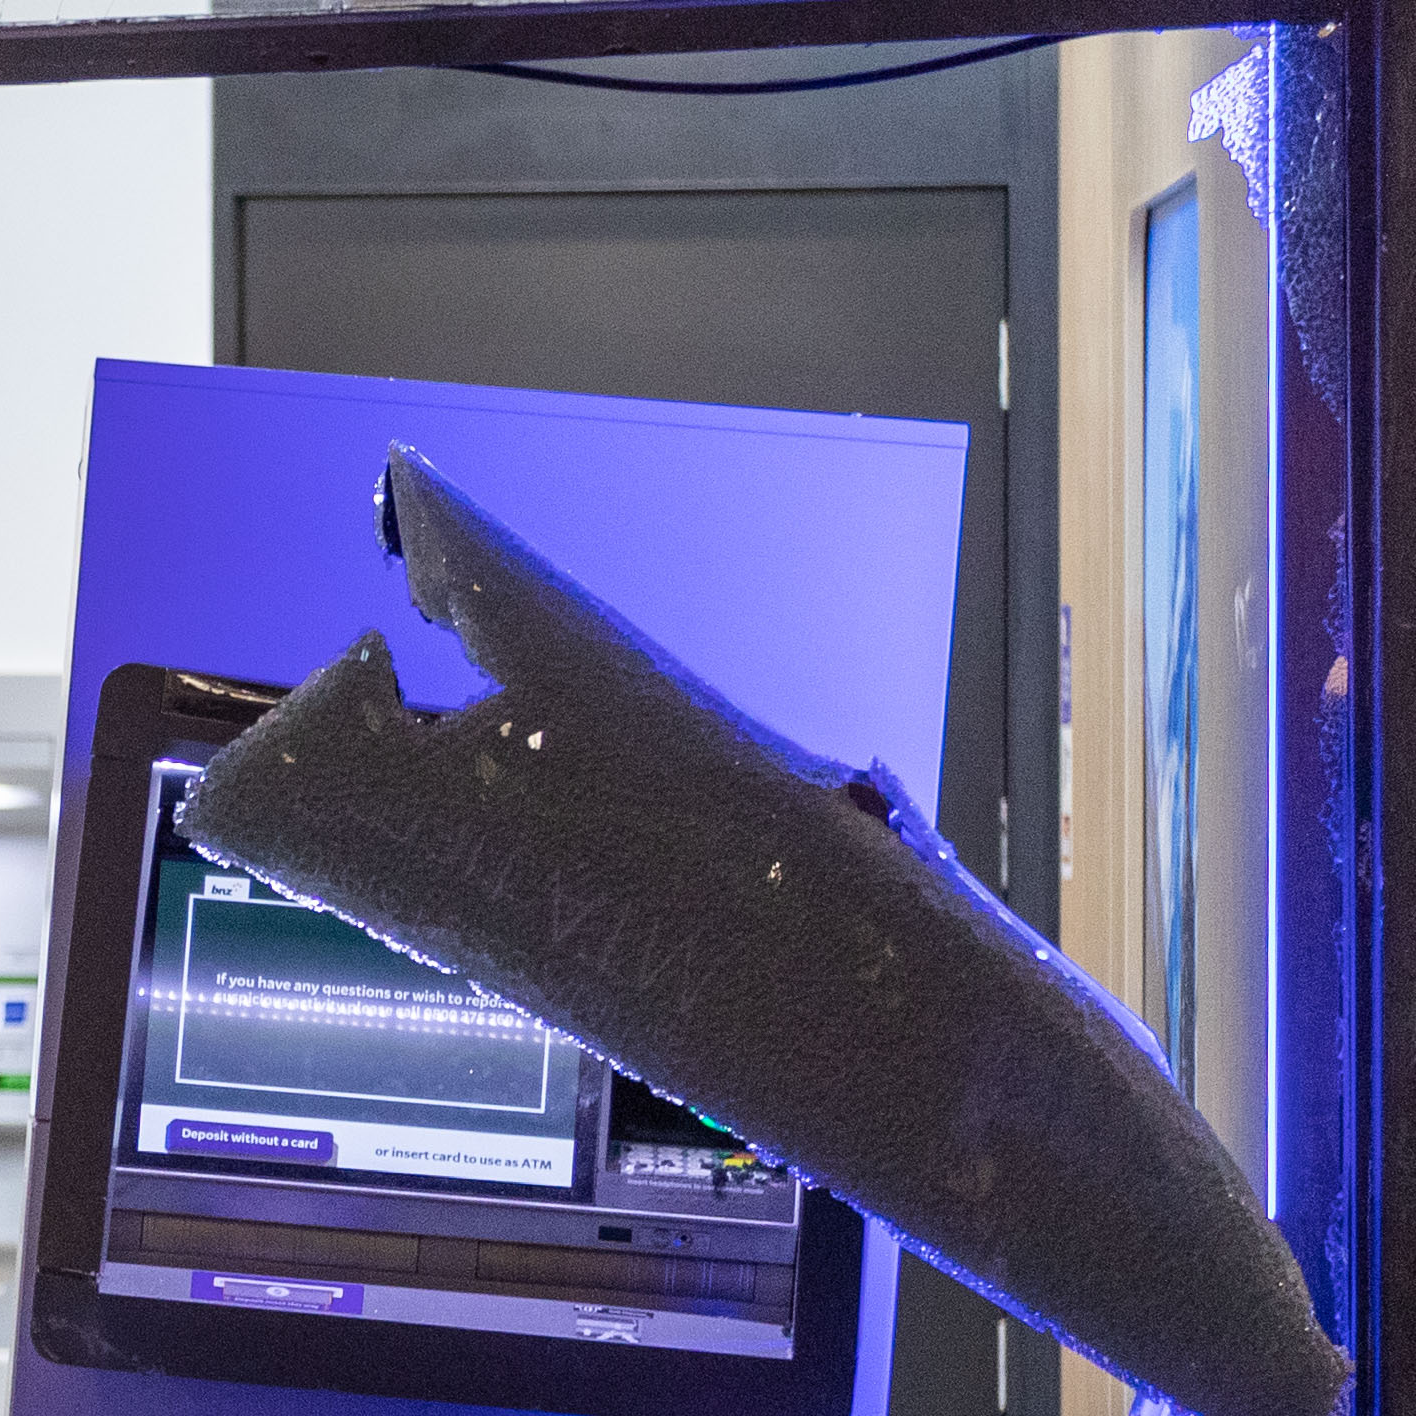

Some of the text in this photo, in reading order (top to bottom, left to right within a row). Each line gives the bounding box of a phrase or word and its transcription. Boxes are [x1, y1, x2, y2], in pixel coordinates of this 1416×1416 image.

[211, 884, 233, 896] bnz
[216, 972, 509, 1010] If you have any questions or wish to repor
[395, 1005, 420, 1020] call
[423, 1007, 458, 1023] 0800
[181, 1127, 319, 1150] Deposit without a card
[375, 1146, 553, 1171] or insert card to use as ATM
